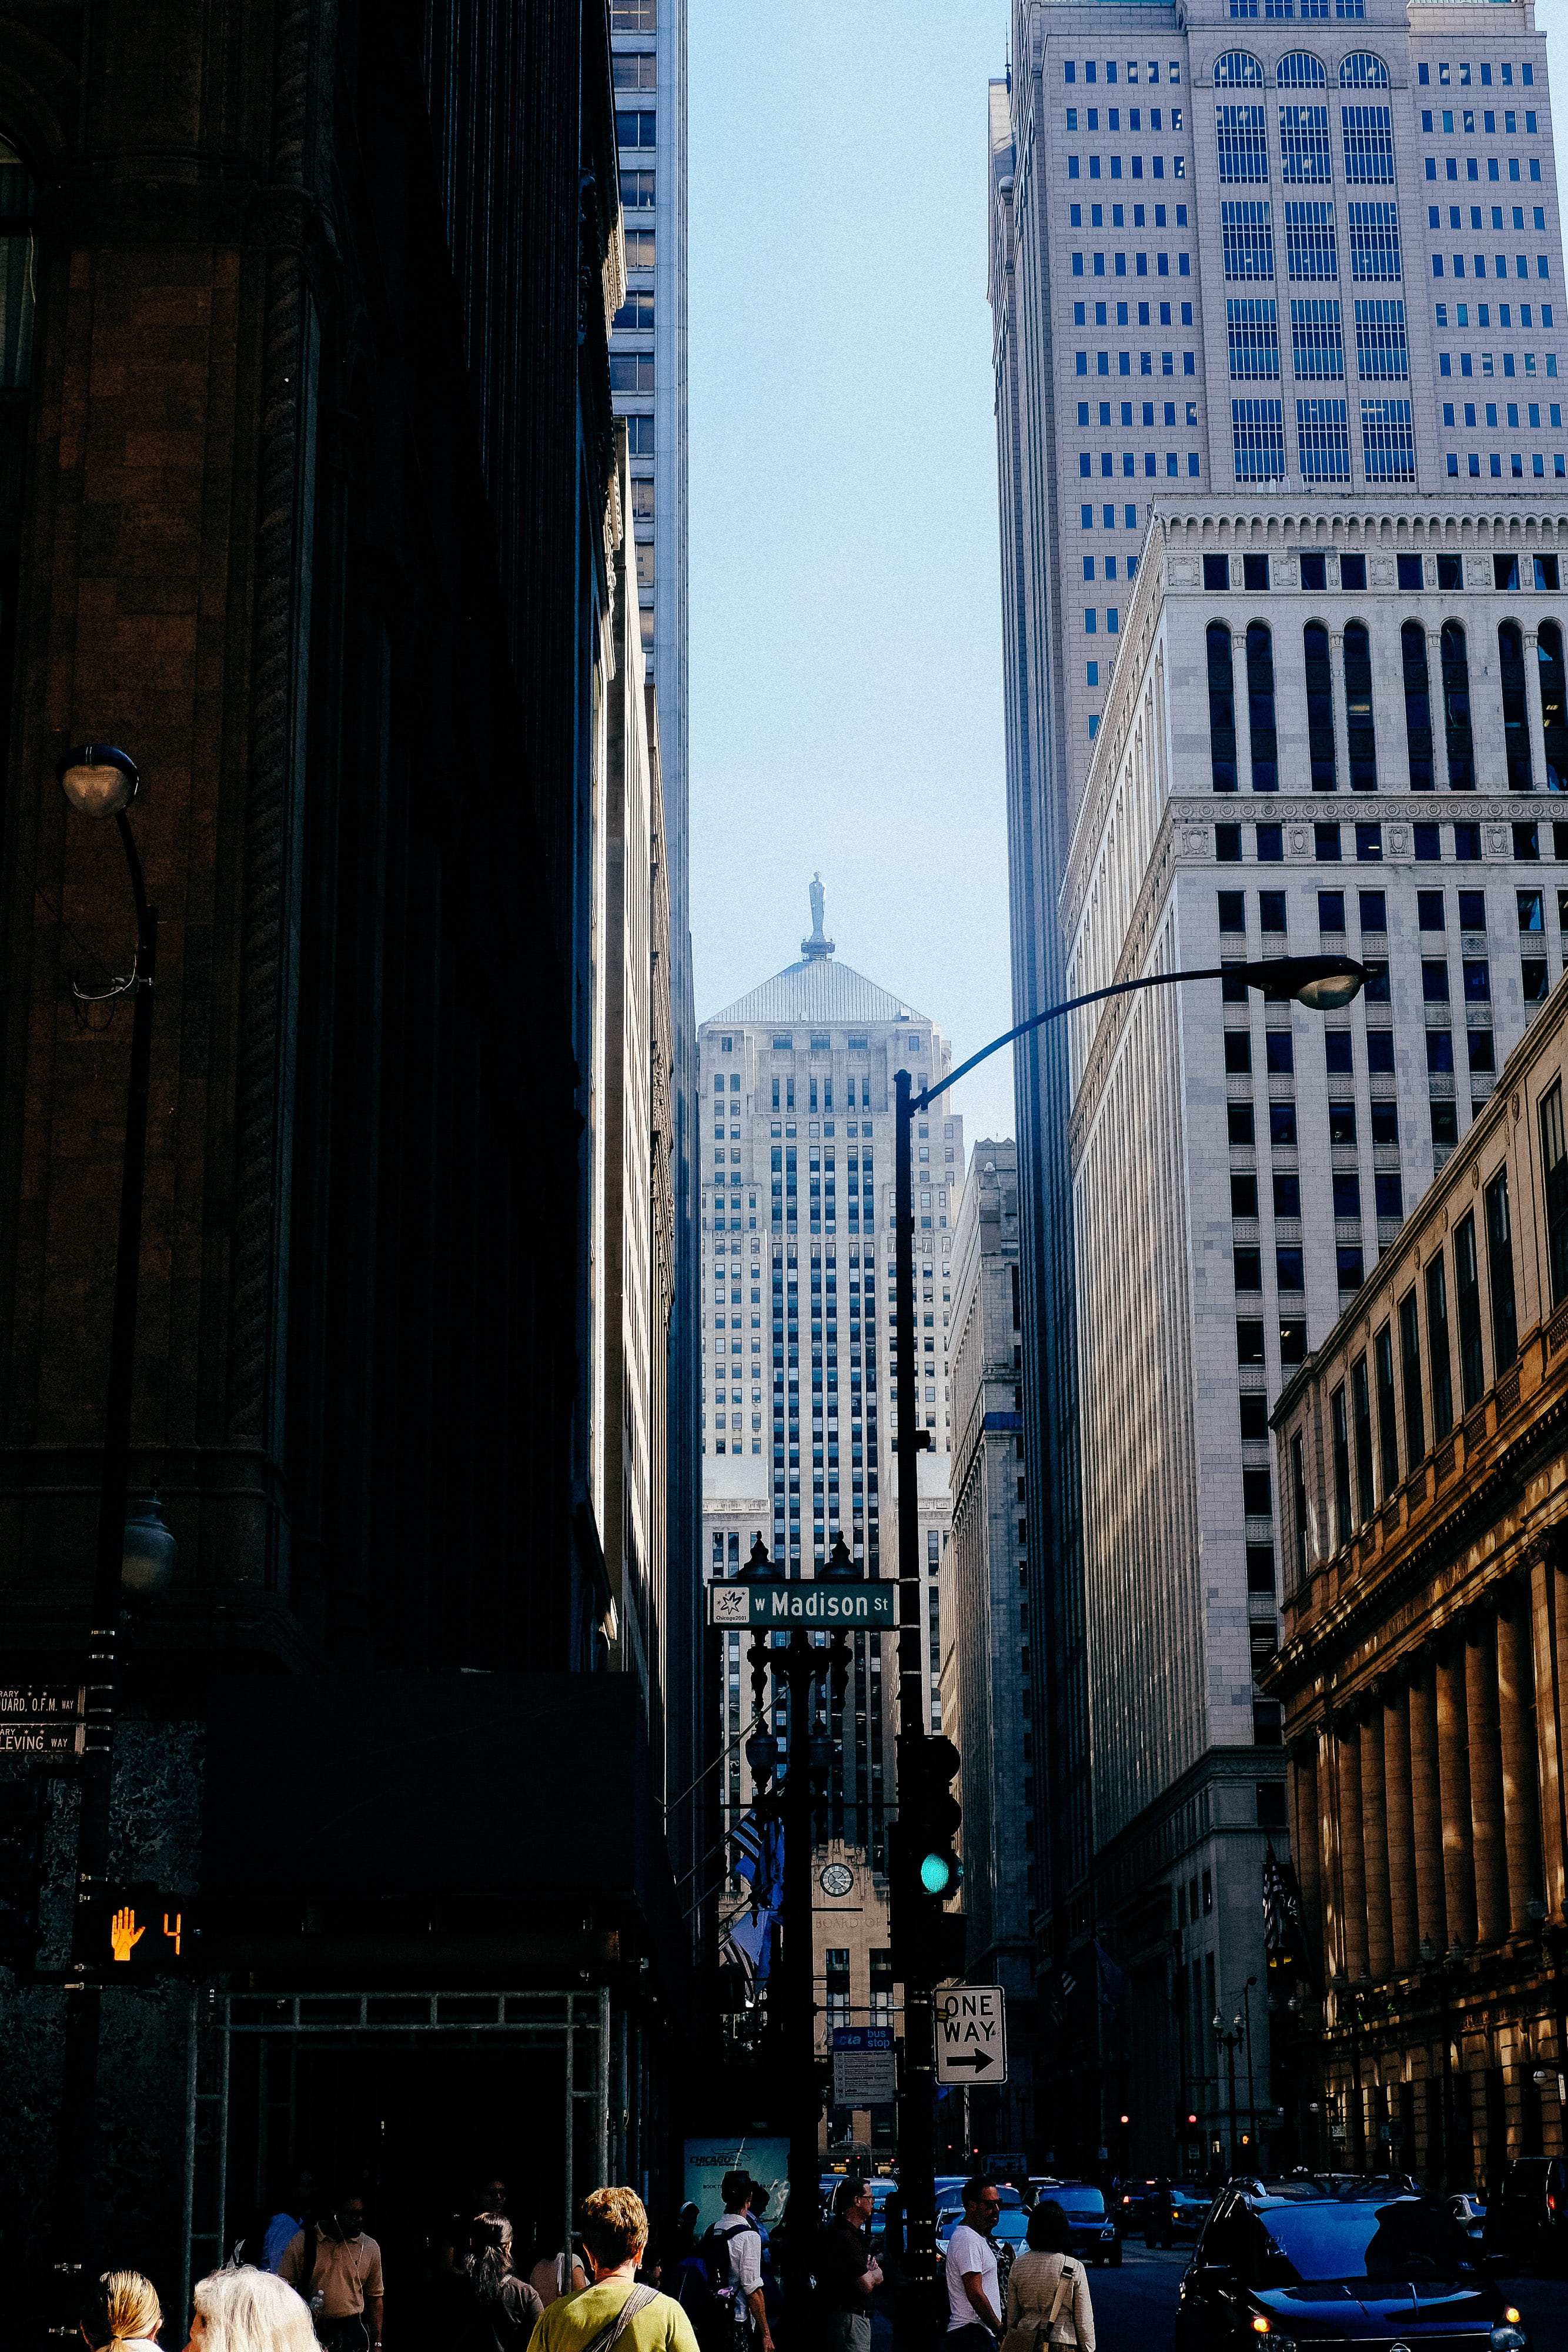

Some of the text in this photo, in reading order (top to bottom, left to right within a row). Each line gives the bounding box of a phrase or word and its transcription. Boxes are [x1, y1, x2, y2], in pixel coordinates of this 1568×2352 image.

[755, 1591, 888, 1616] W Madison St
[32, 1698, 58, 1711] O.F.M.
[62, 1700, 73, 1709] WAY
[51, 1739, 68, 1747] WAY
[163, 1913, 181, 1955] 4
[944, 1995, 994, 2016] ONE
[867, 2029, 886, 2037] bus
[943, 2021, 995, 2042] WAY
[867, 2038, 890, 2049] stop
